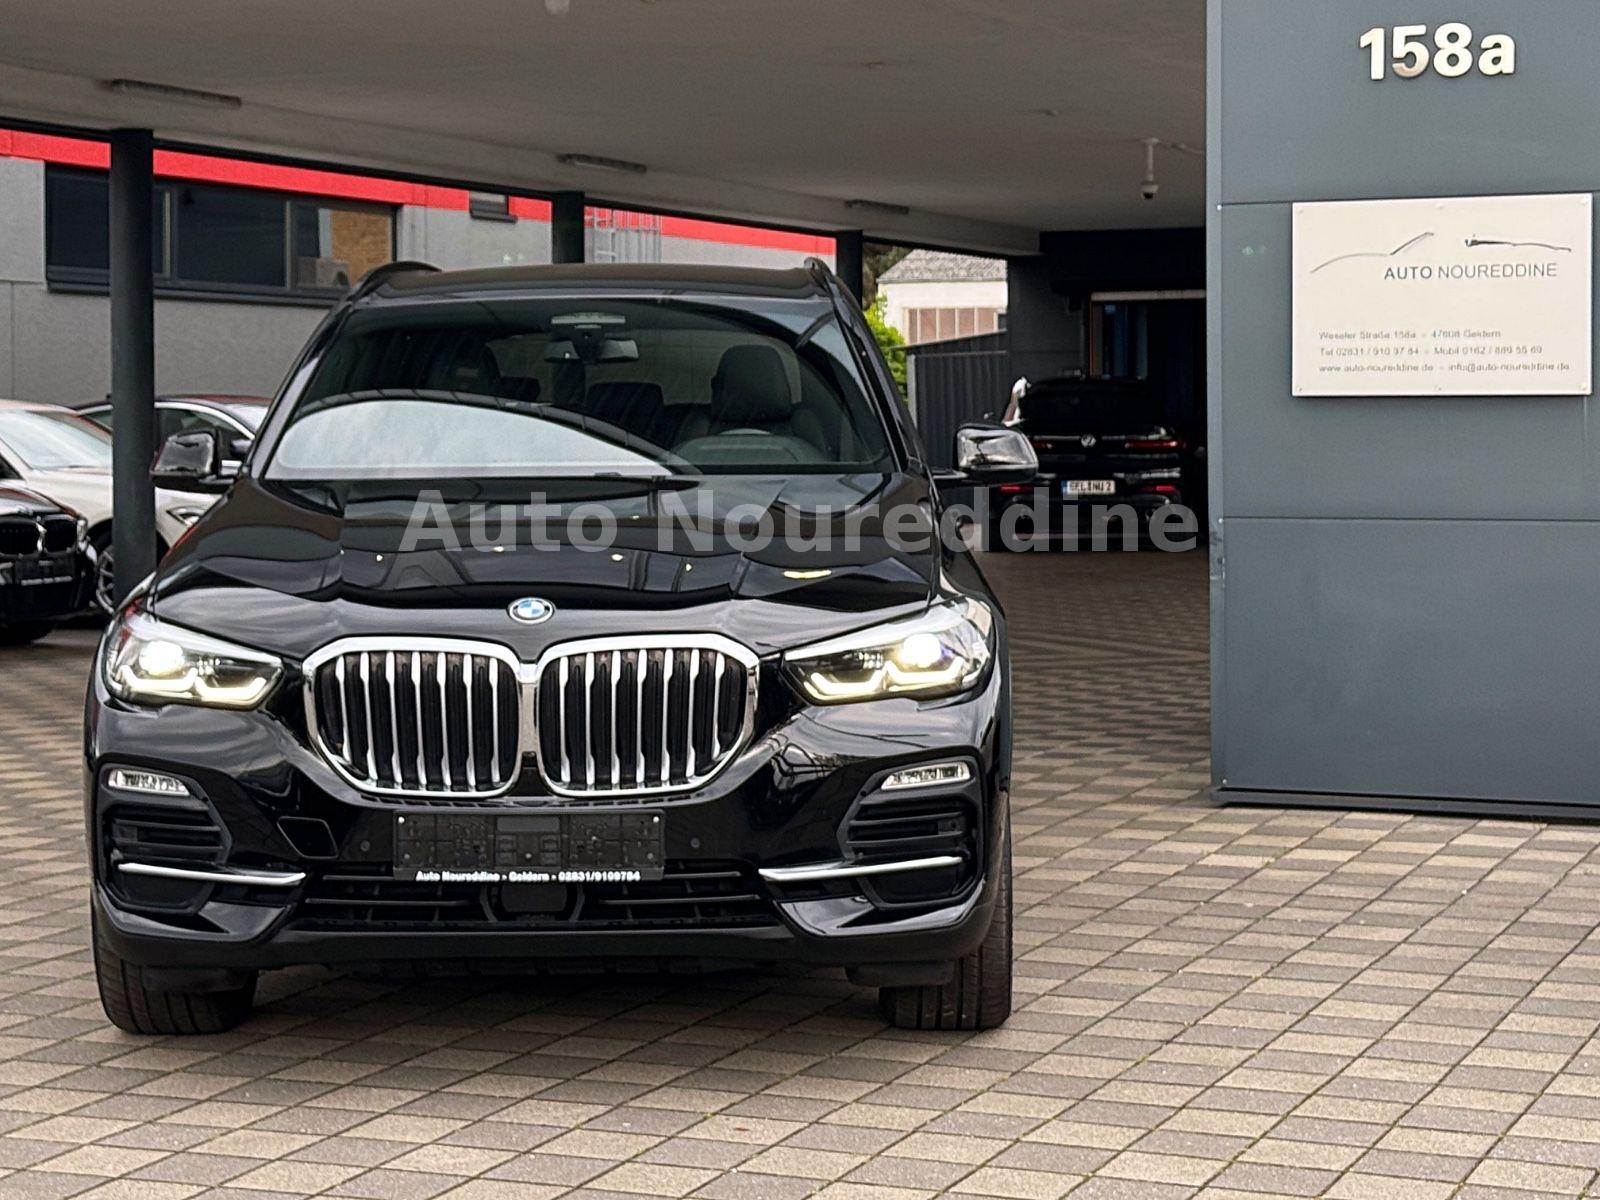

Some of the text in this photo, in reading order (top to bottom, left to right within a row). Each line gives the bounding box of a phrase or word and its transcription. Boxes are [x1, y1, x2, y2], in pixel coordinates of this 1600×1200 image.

[1360, 22, 1515, 80] 158a
[1384, 262, 1557, 280] AUTO NOUREDDINE
[415, 870, 441, 882] Auto
[441, 870, 501, 882] Noureddine
[508, 871, 550, 882] Geldern
